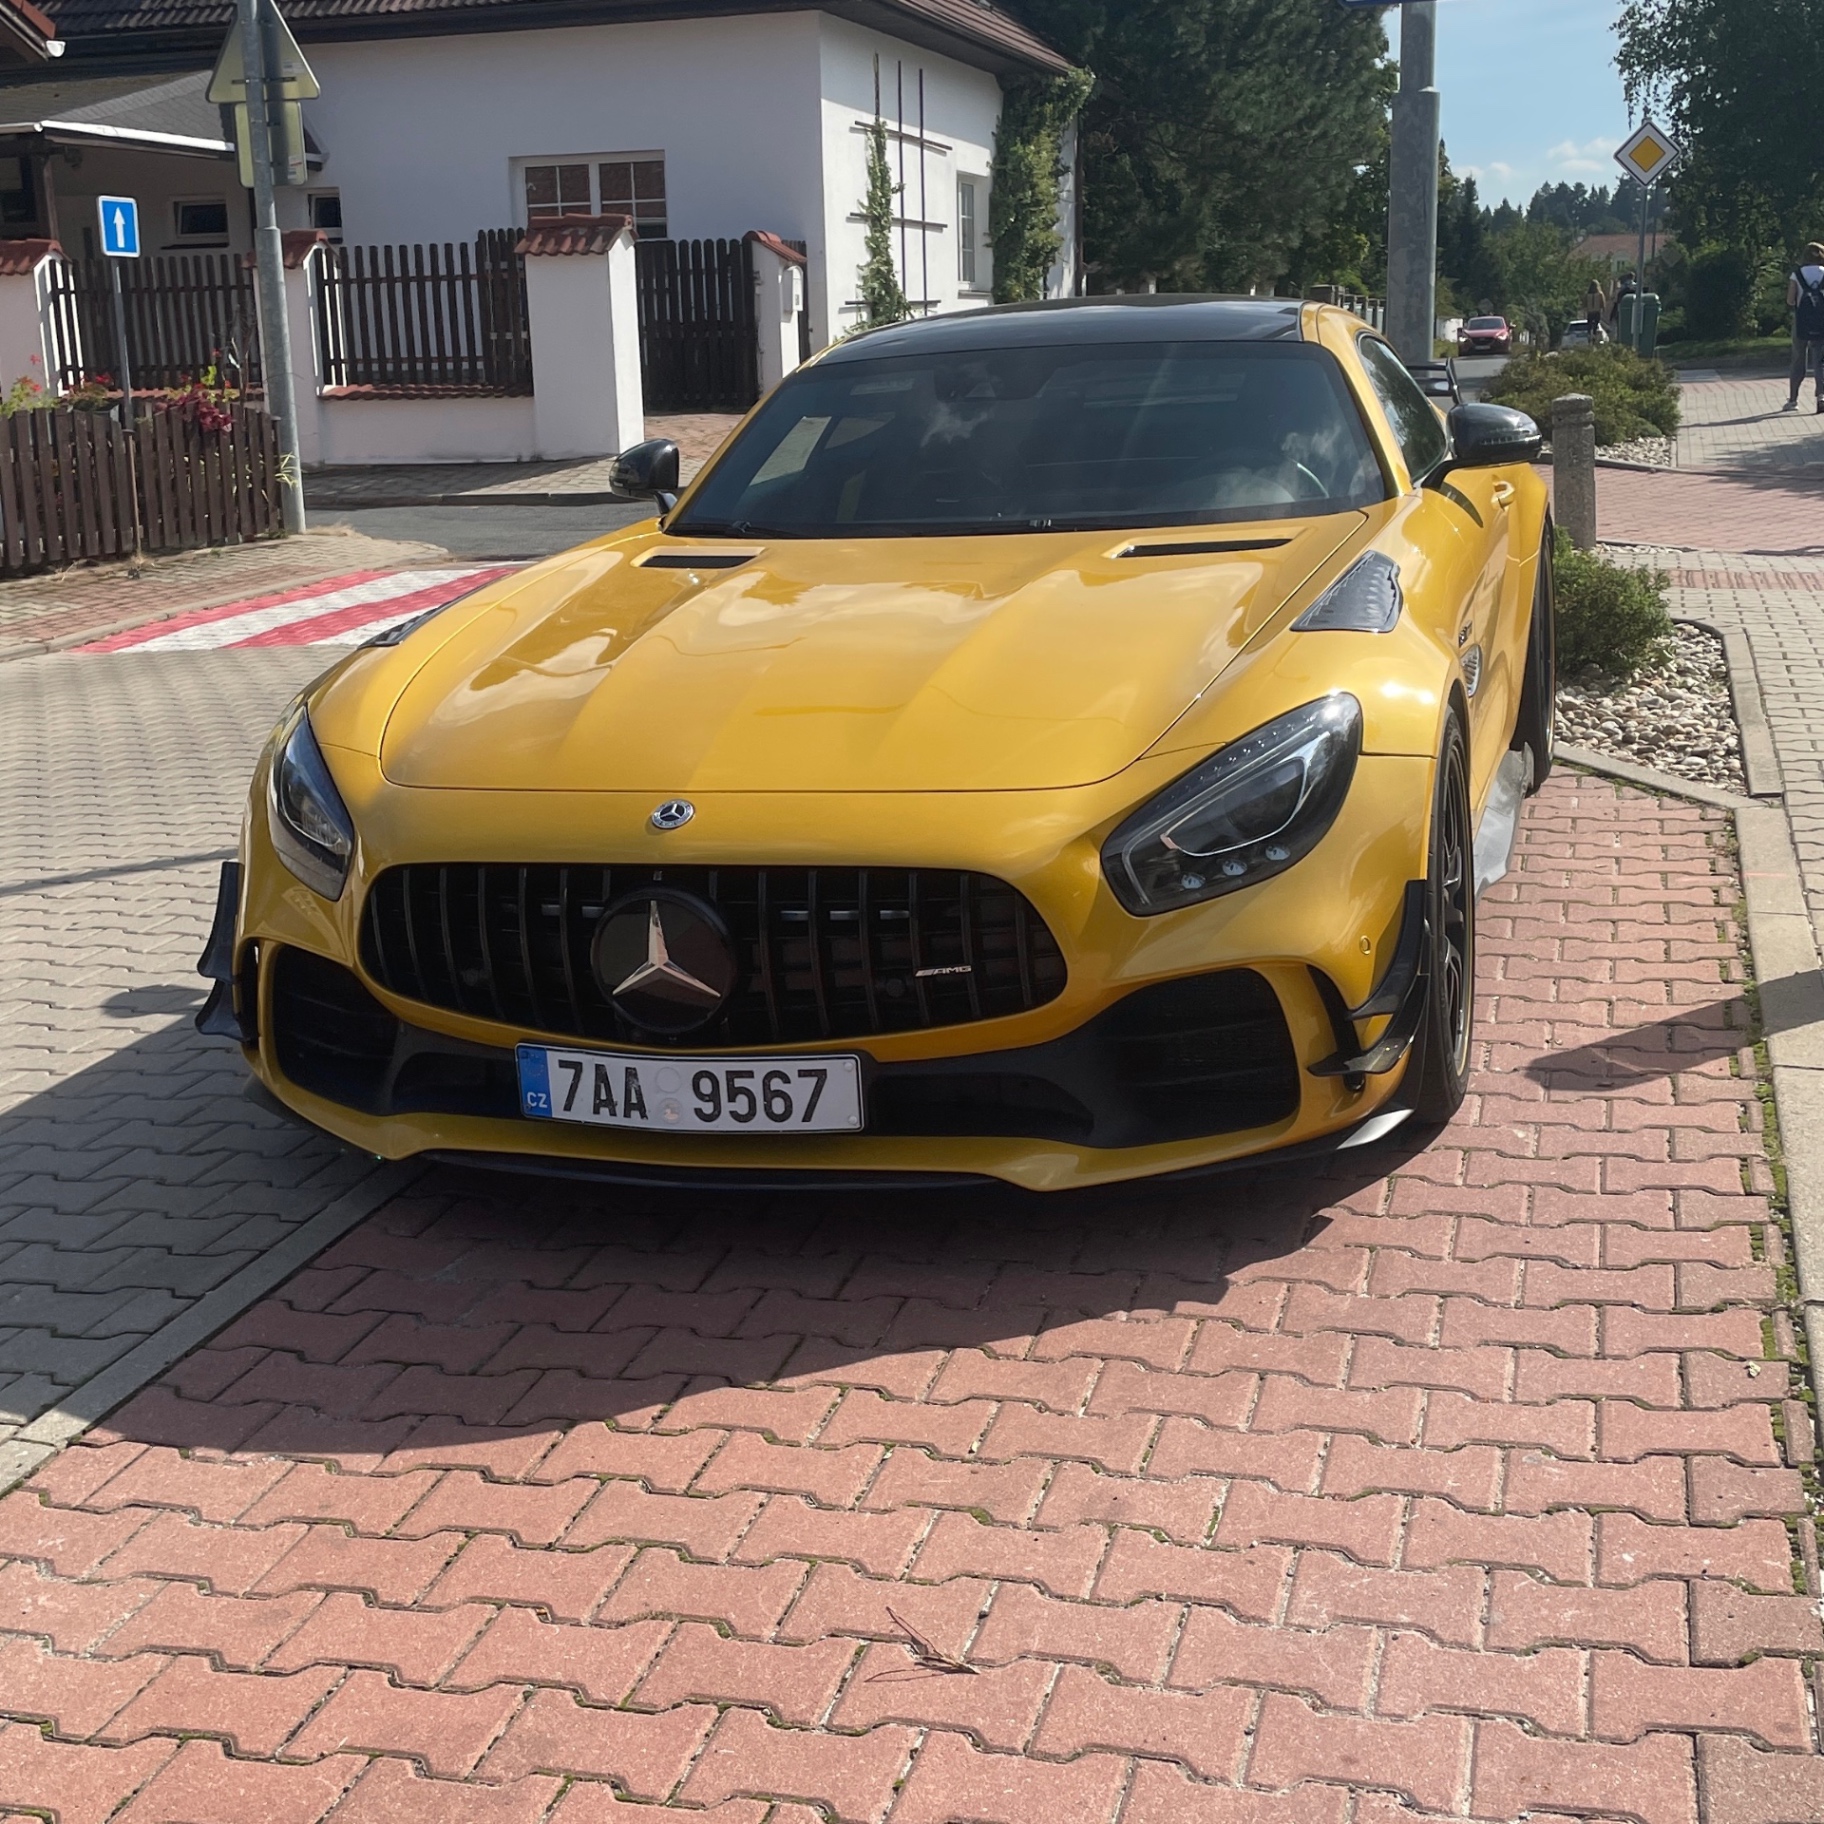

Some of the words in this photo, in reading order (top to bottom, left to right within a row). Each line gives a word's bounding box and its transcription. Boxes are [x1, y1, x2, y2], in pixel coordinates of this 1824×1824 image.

[932, 965, 972, 976] AMG
[526, 1091, 548, 1108] CZ
[558, 1059, 649, 1120] 7AA
[692, 1069, 828, 1124] 9567
